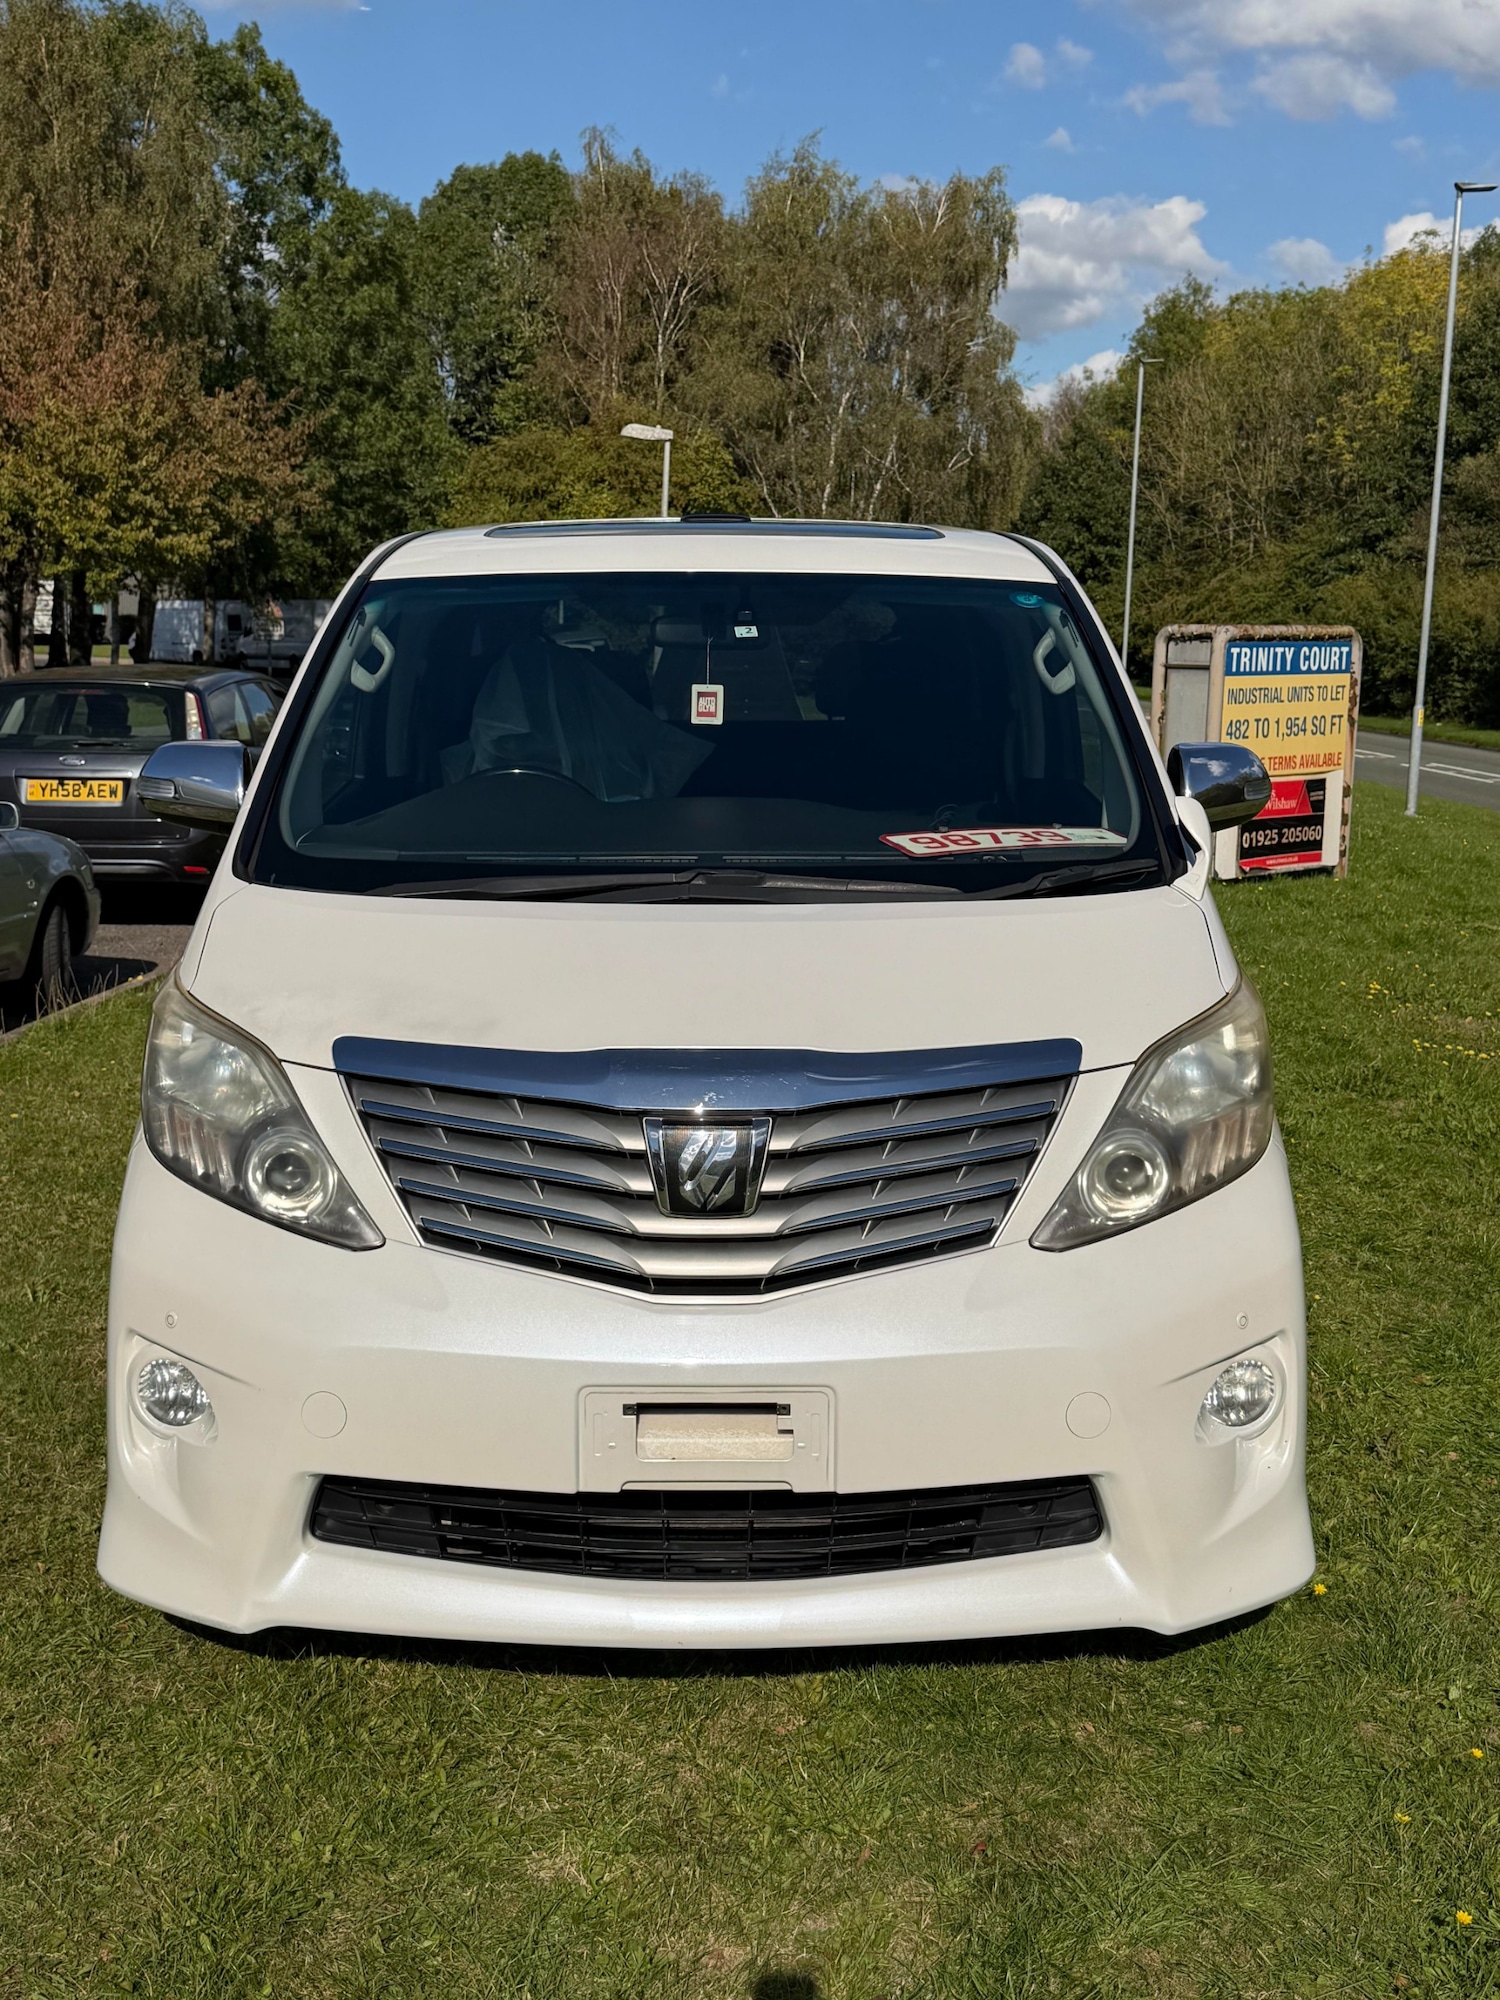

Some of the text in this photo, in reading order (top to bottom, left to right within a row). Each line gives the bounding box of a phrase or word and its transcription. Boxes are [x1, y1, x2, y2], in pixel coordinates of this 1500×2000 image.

[1230, 646, 1350, 672] TRINITY COURT
[1227, 684, 1346, 705] INDUSTRIAL UNITS TO LET
[1225, 714, 1344, 742] 482 TO 1,954 SQ FT
[1268, 755, 1297, 772] TERMS
[1298, 752, 1342, 769] AVAILABLE
[39, 782, 82, 798] YH58
[86, 783, 119, 799] AEW
[908, 830, 1073, 849] 98739
[1242, 825, 1322, 849] 01925 205060
